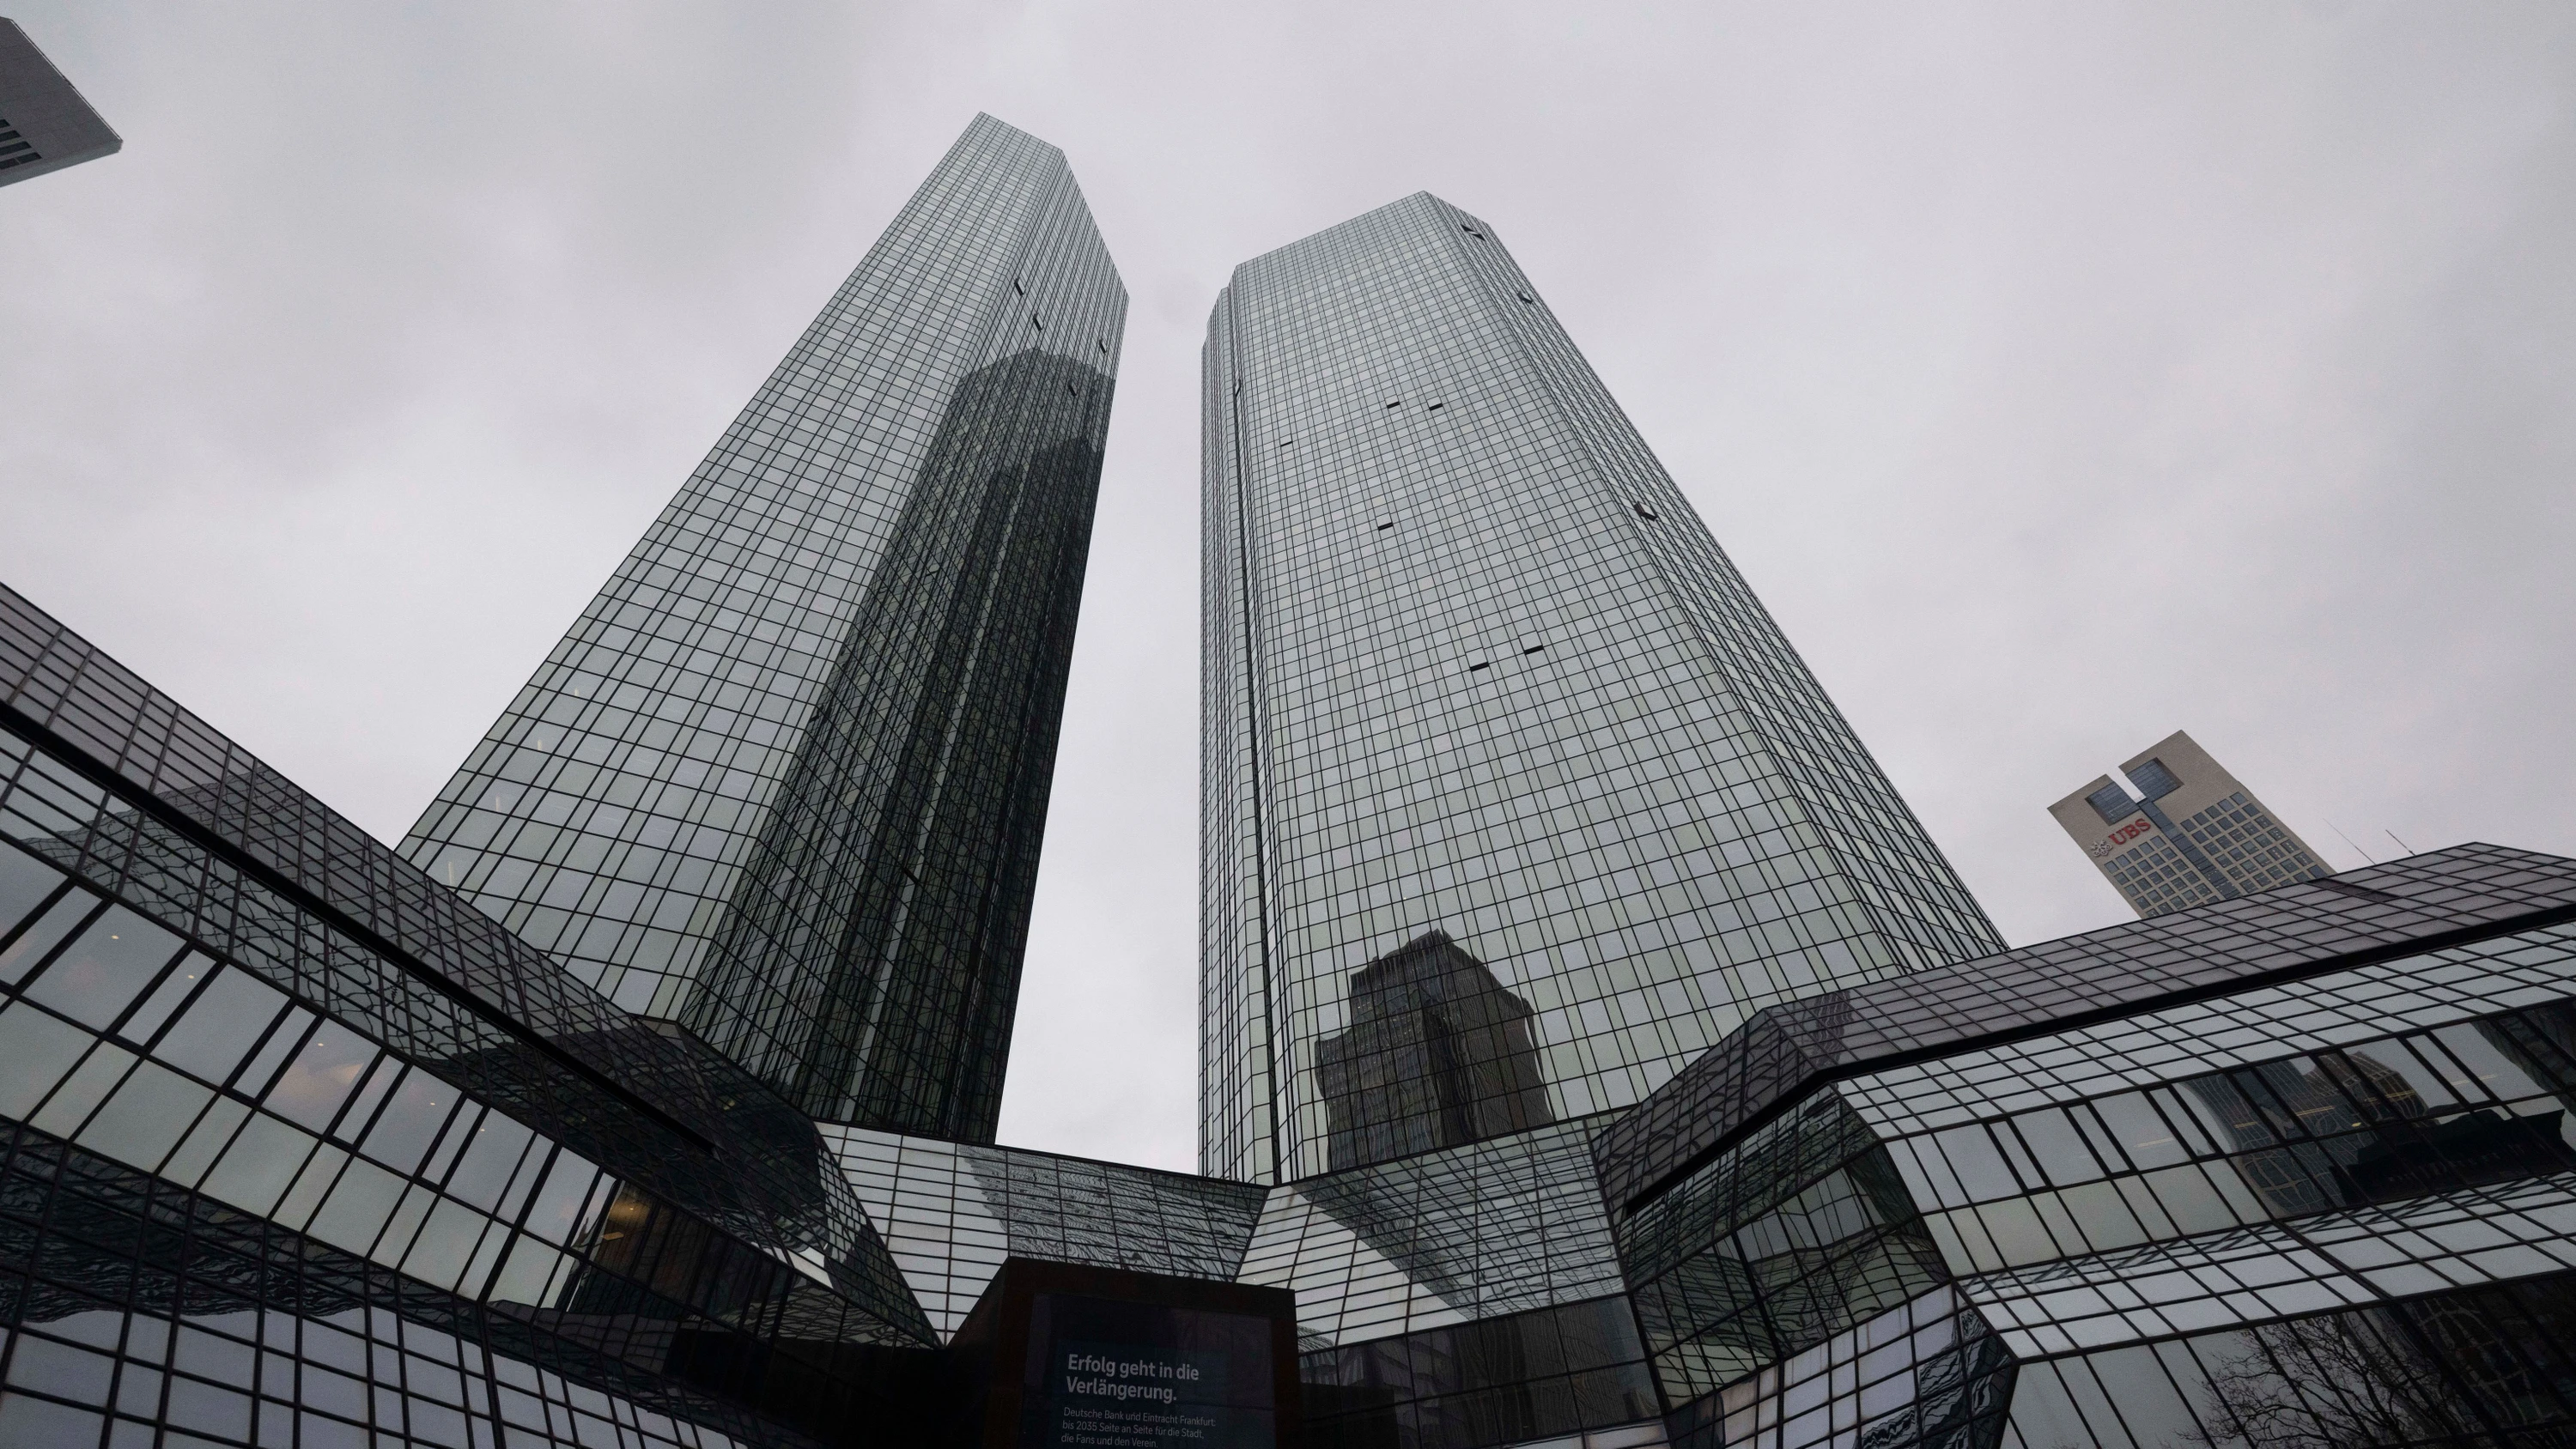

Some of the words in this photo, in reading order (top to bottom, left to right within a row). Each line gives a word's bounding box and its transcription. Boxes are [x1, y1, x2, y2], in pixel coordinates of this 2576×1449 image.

[2108, 817, 2152, 846] UBS
[1067, 1354, 1116, 1378] Erfolg
[1120, 1360, 1156, 1379] geht
[1159, 1361, 1173, 1379] in
[1176, 1363, 1200, 1380] die
[1066, 1375, 1177, 1404] Verlängerung.
[1063, 1407, 1103, 1419] Deutsche
[1104, 1410, 1124, 1421] Bank
[1126, 1412, 1141, 1422] und
[1142, 1412, 1178, 1424] Eintracht
[1060, 1433, 1074, 1443] die
[1076, 1434, 1096, 1445] Fans
[1097, 1436, 1113, 1446] und
[1115, 1436, 1130, 1446] den
[1131, 1437, 1158, 1448] Verein.
[1062, 1420, 1075, 1429] bis
[1076, 1421, 1097, 1431] 2035
[1099, 1422, 1120, 1433] Seite
[1133, 1424, 1153, 1434] Seite
[1155, 1425, 1167, 1435] für
[1167, 1428, 1180, 1437] die
[1181, 1428, 1205, 1440] Stadt,
